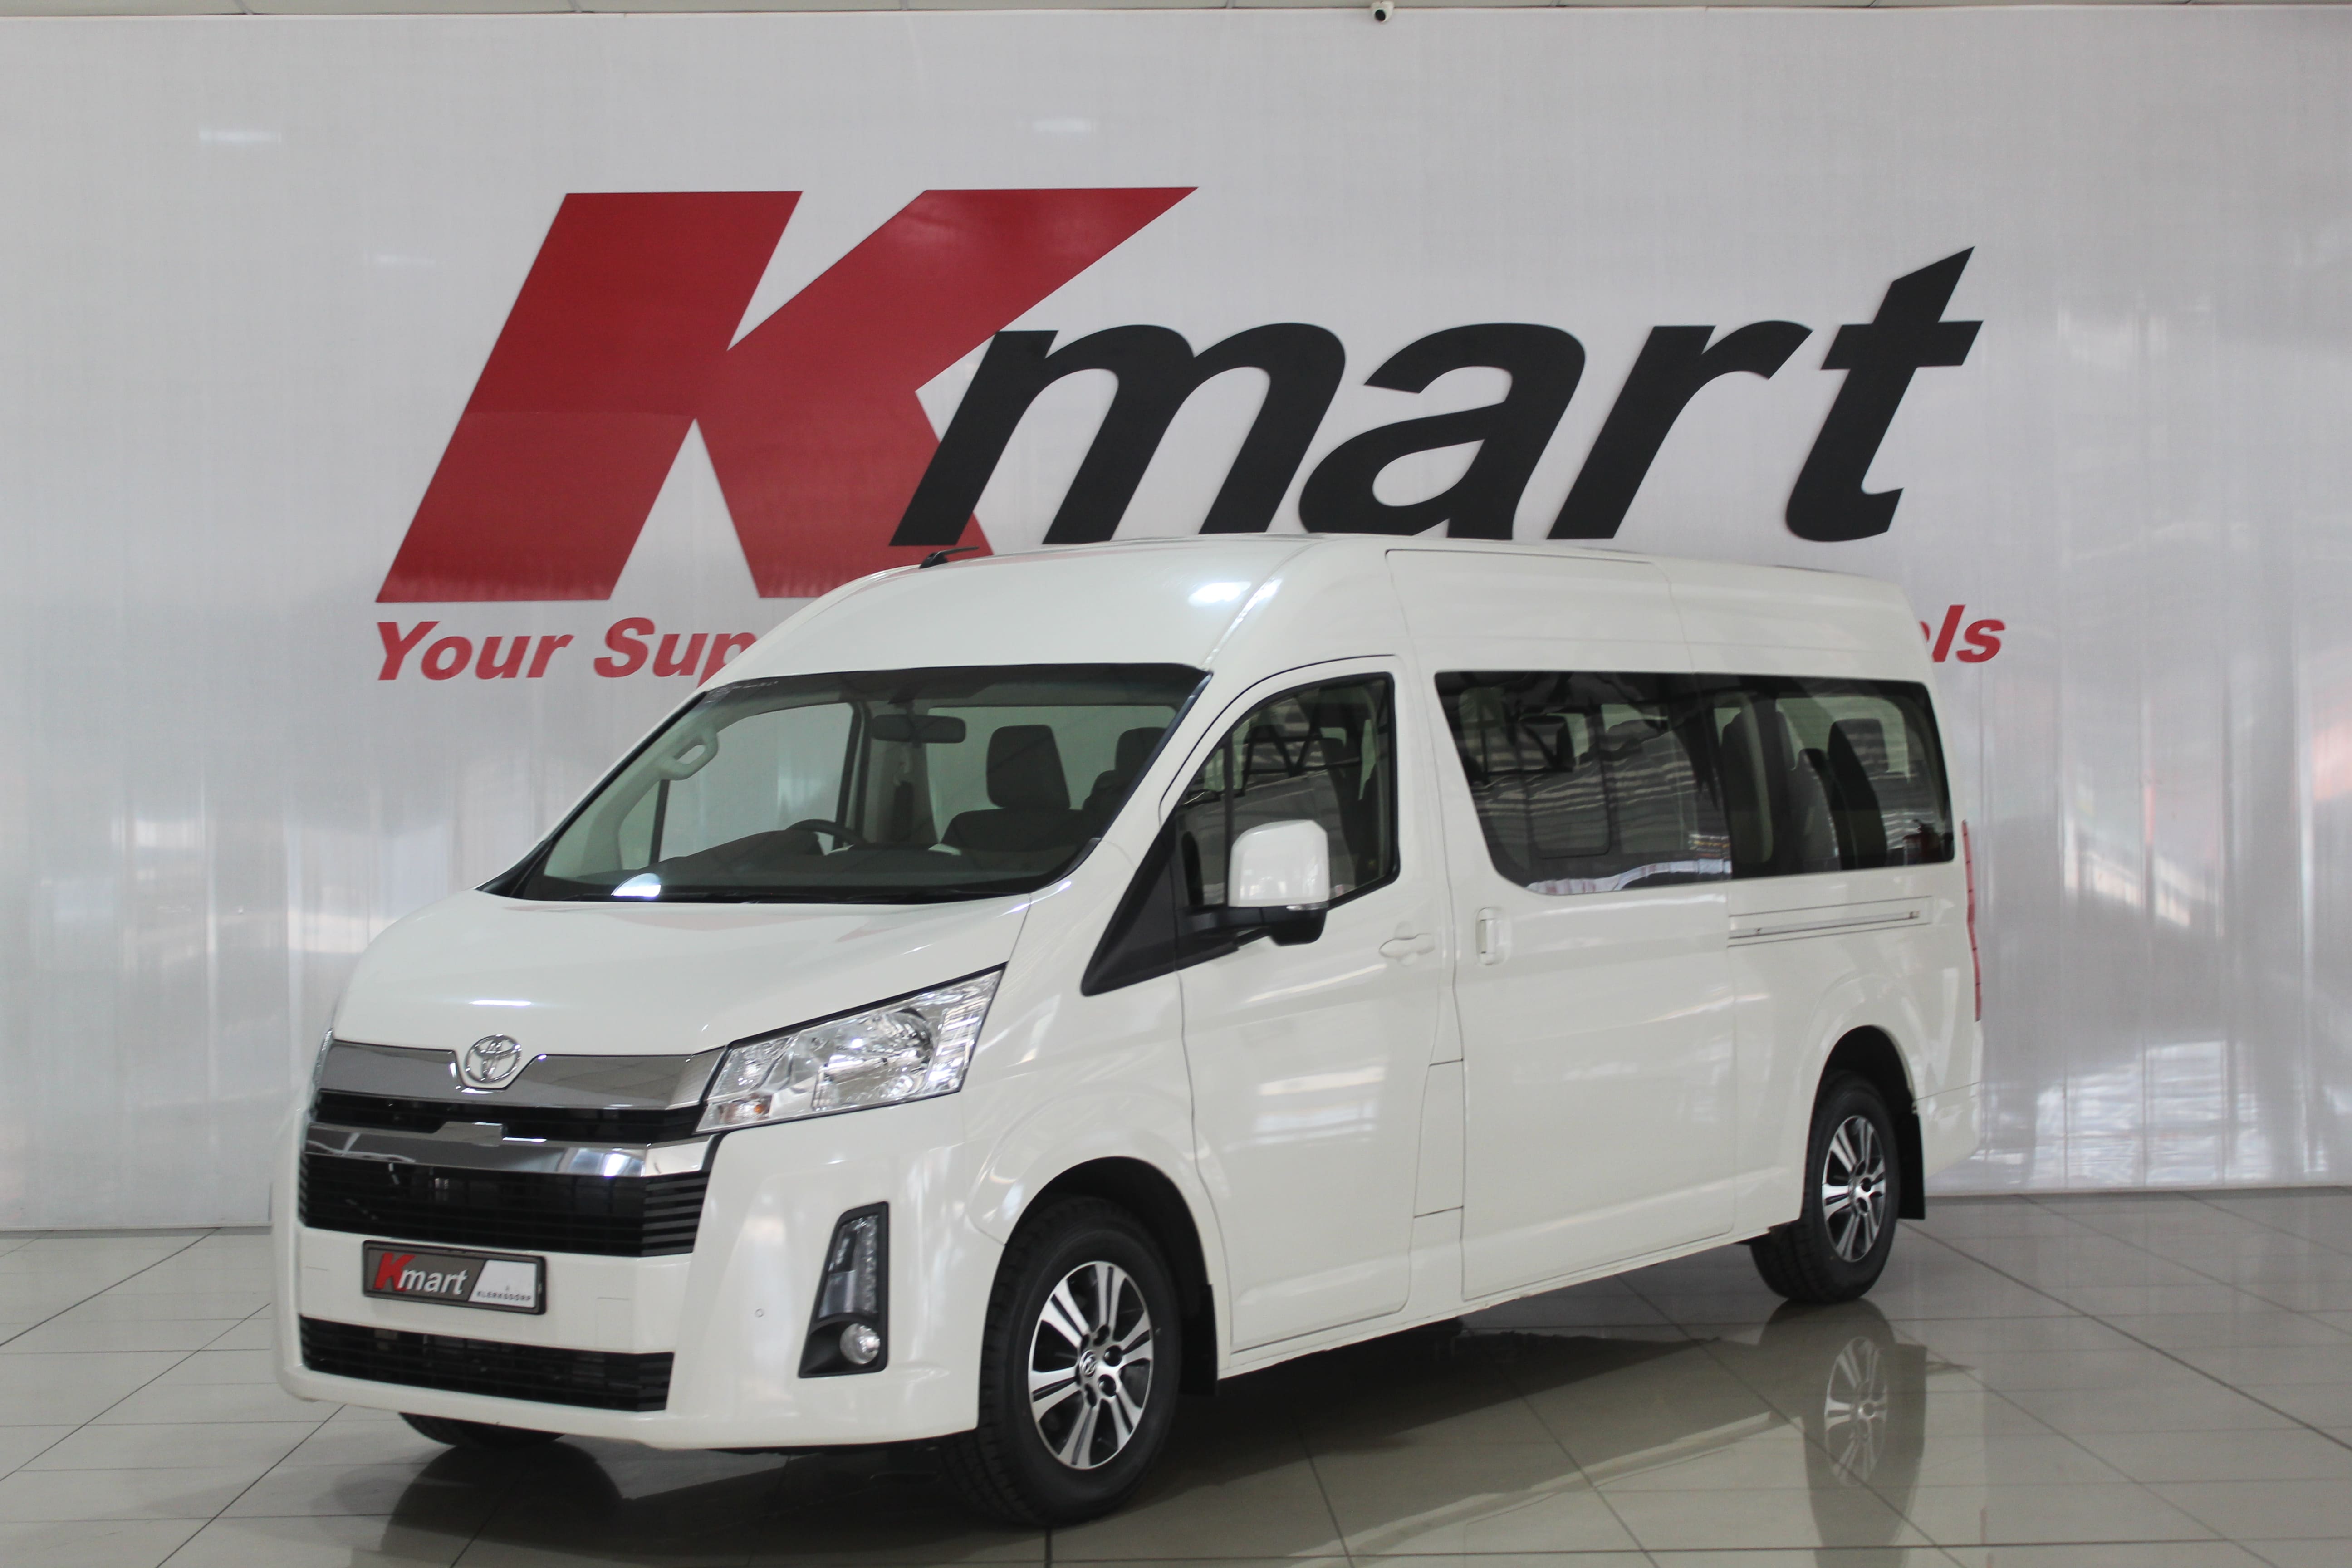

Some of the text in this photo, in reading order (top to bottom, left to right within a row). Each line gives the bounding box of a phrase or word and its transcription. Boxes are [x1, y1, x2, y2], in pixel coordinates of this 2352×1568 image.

[375, 186, 1983, 602] Kmart
[376, 620, 575, 681] Your
[1919, 604, 2006, 663] ls
[373, 1252, 468, 1295] Kmart
[477, 1291, 532, 1301] KLERKSDORP
